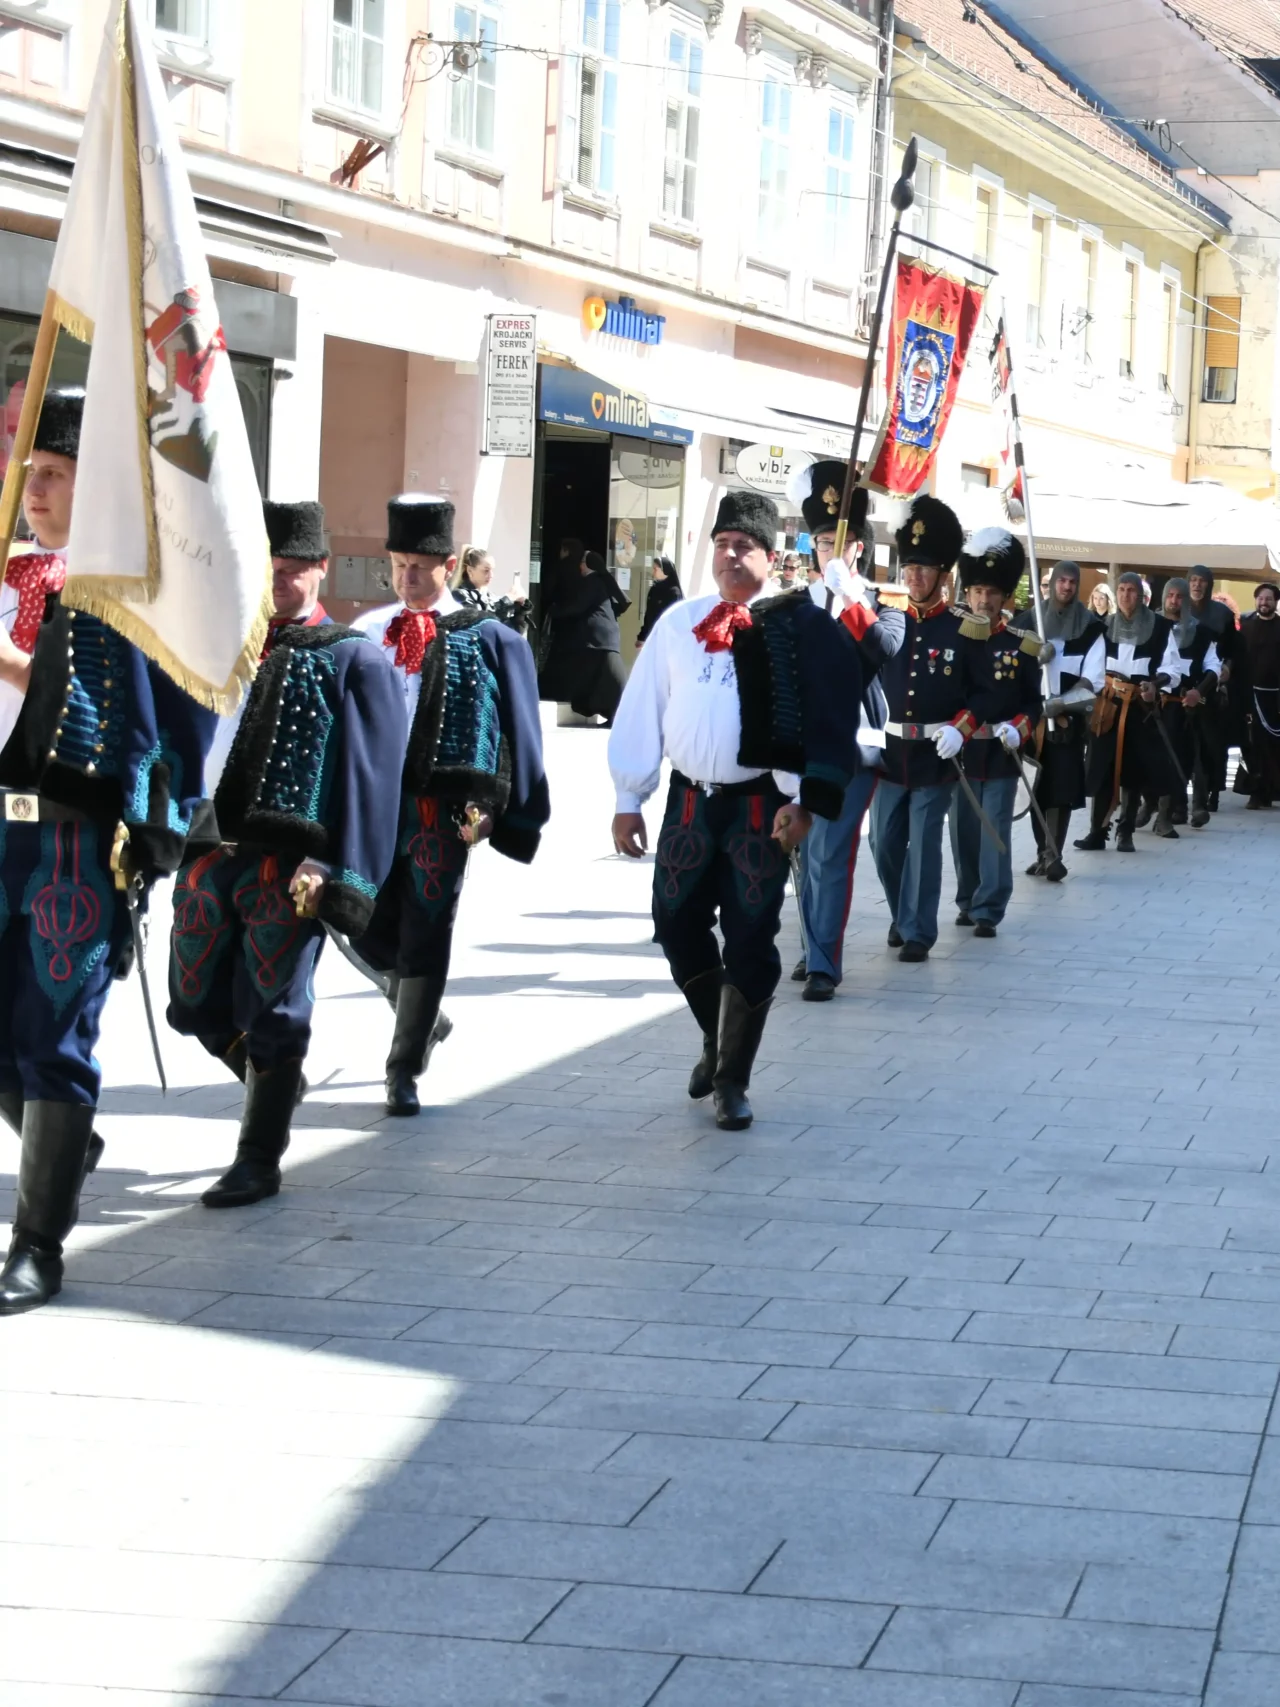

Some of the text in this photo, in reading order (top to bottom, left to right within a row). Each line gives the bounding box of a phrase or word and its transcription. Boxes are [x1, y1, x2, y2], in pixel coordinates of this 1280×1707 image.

[496, 320, 530, 330] EXPRES
[602, 296, 666, 345] mlinar
[499, 340, 527, 348] SERVIS
